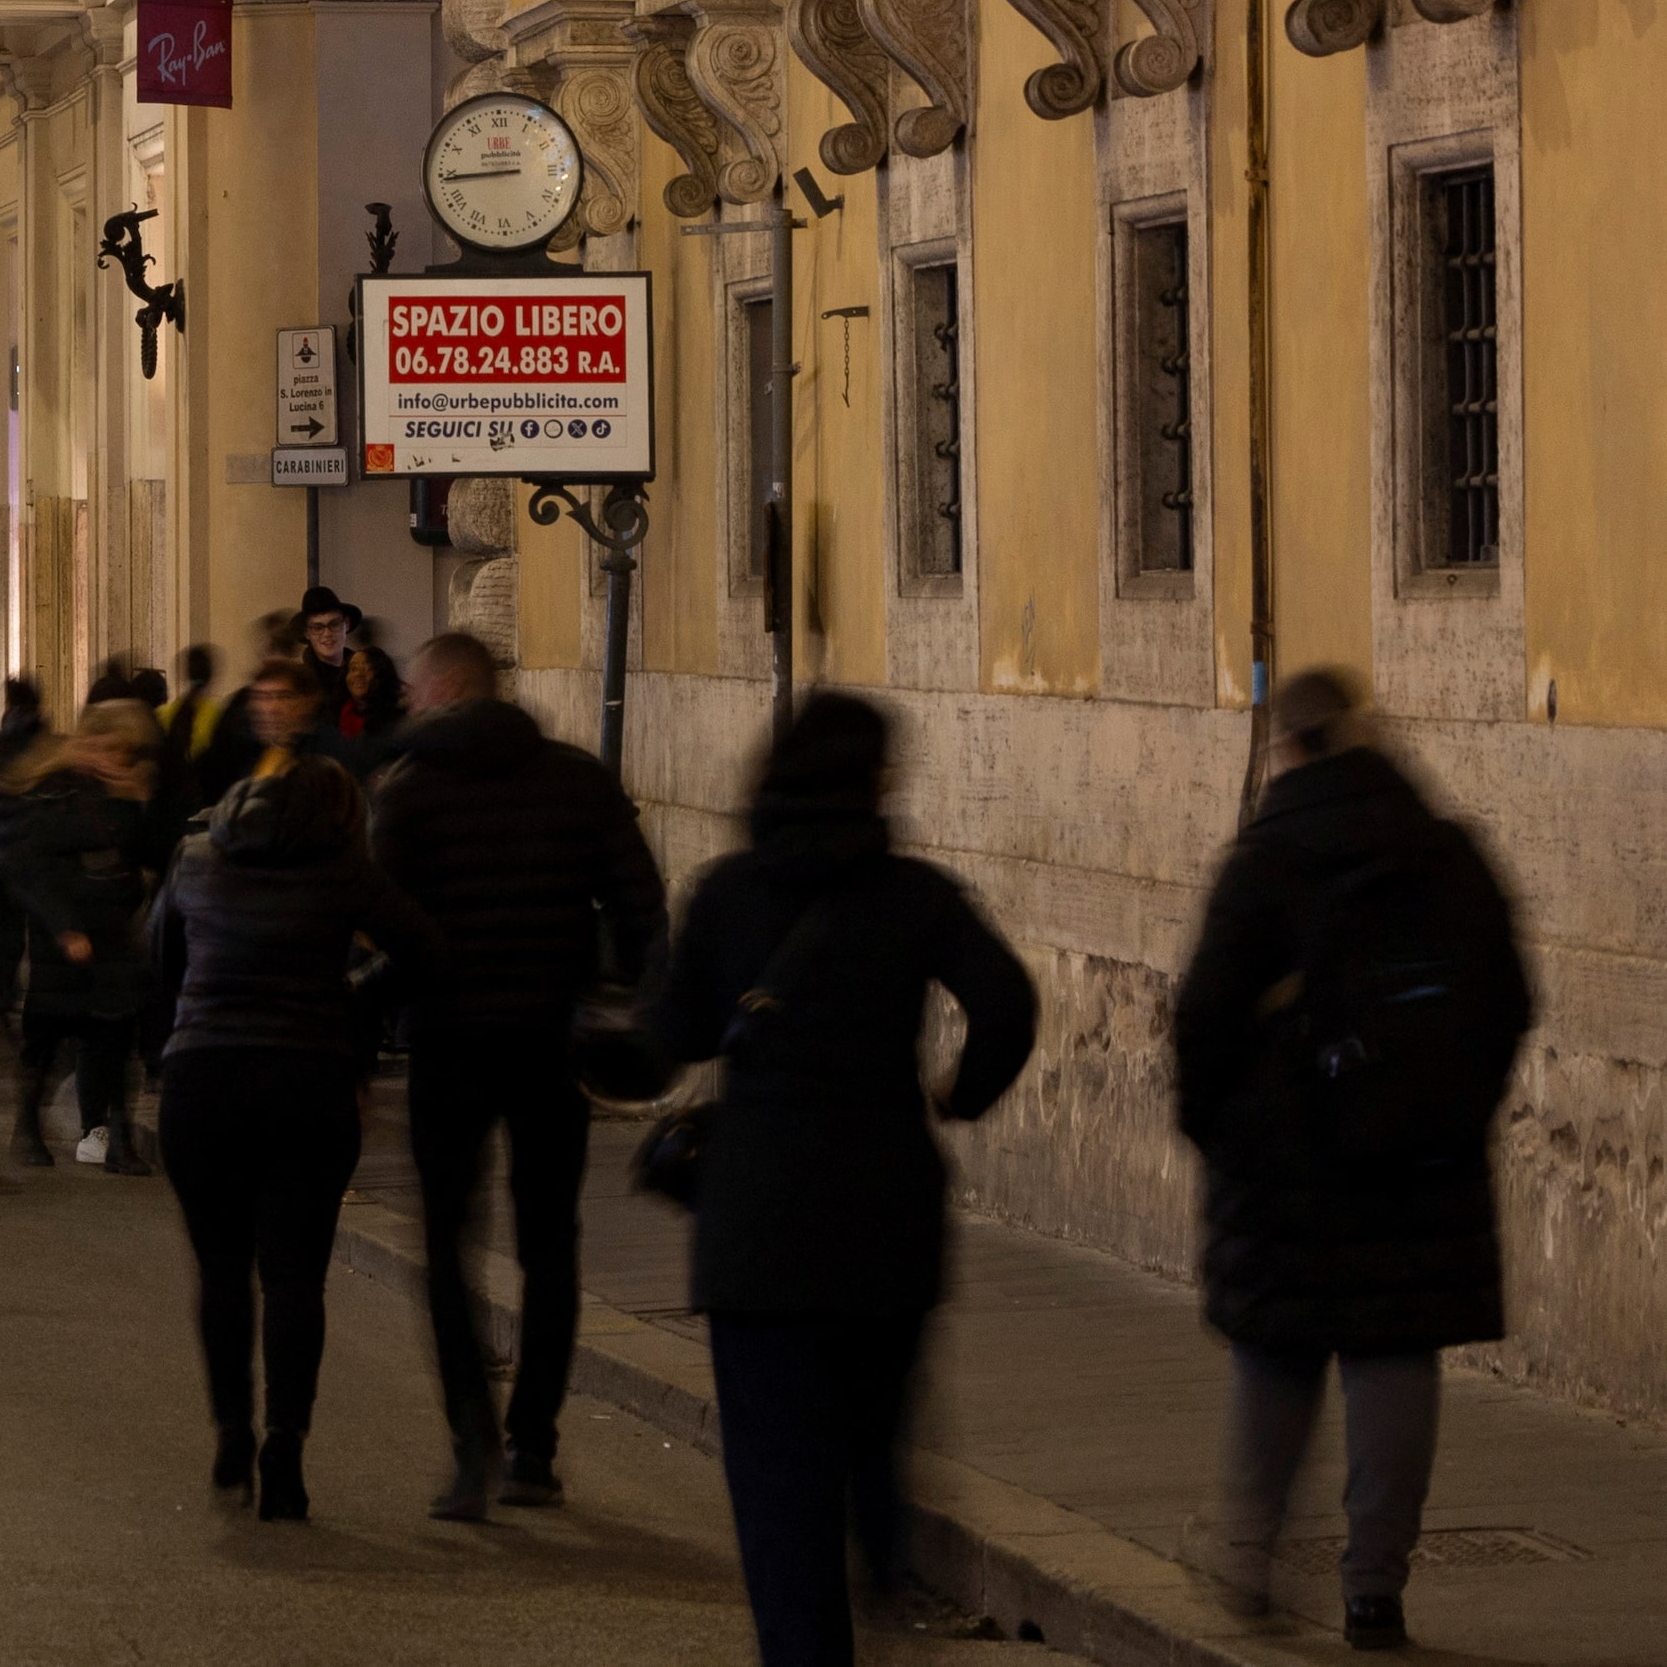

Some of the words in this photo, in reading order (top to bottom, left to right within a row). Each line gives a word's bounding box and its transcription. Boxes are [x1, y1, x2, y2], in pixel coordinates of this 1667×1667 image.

[491, 117, 508, 128] XII
[468, 124, 482, 137] XI
[451, 145, 463, 155] X
[487, 136, 512, 151] URBE
[539, 141, 550, 151] II
[547, 164, 557, 176] III
[450, 189, 467, 211] VIII
[541, 189, 554, 203] IV
[470, 210, 486, 225] VII
[525, 210, 535, 221] V
[498, 218, 511, 228] VI
[392, 305, 505, 337] SPAZIO
[516, 304, 623, 337] LIBERO
[395, 346, 569, 374] 06.78.24.883
[578, 351, 621, 374] R.A.
[293, 374, 319, 385] piazza
[280, 389, 288, 399] S.
[291, 387, 323, 399] Lorenzo
[325, 386, 332, 396] in
[289, 402, 317, 412] Lucina
[319, 401, 324, 410] 6
[398, 393, 619, 413] info@urbepubblicita.com
[405, 420, 482, 438] SEGUICI
[488, 420, 514, 438] SU
[276, 460, 344, 474] CARABINIERI
